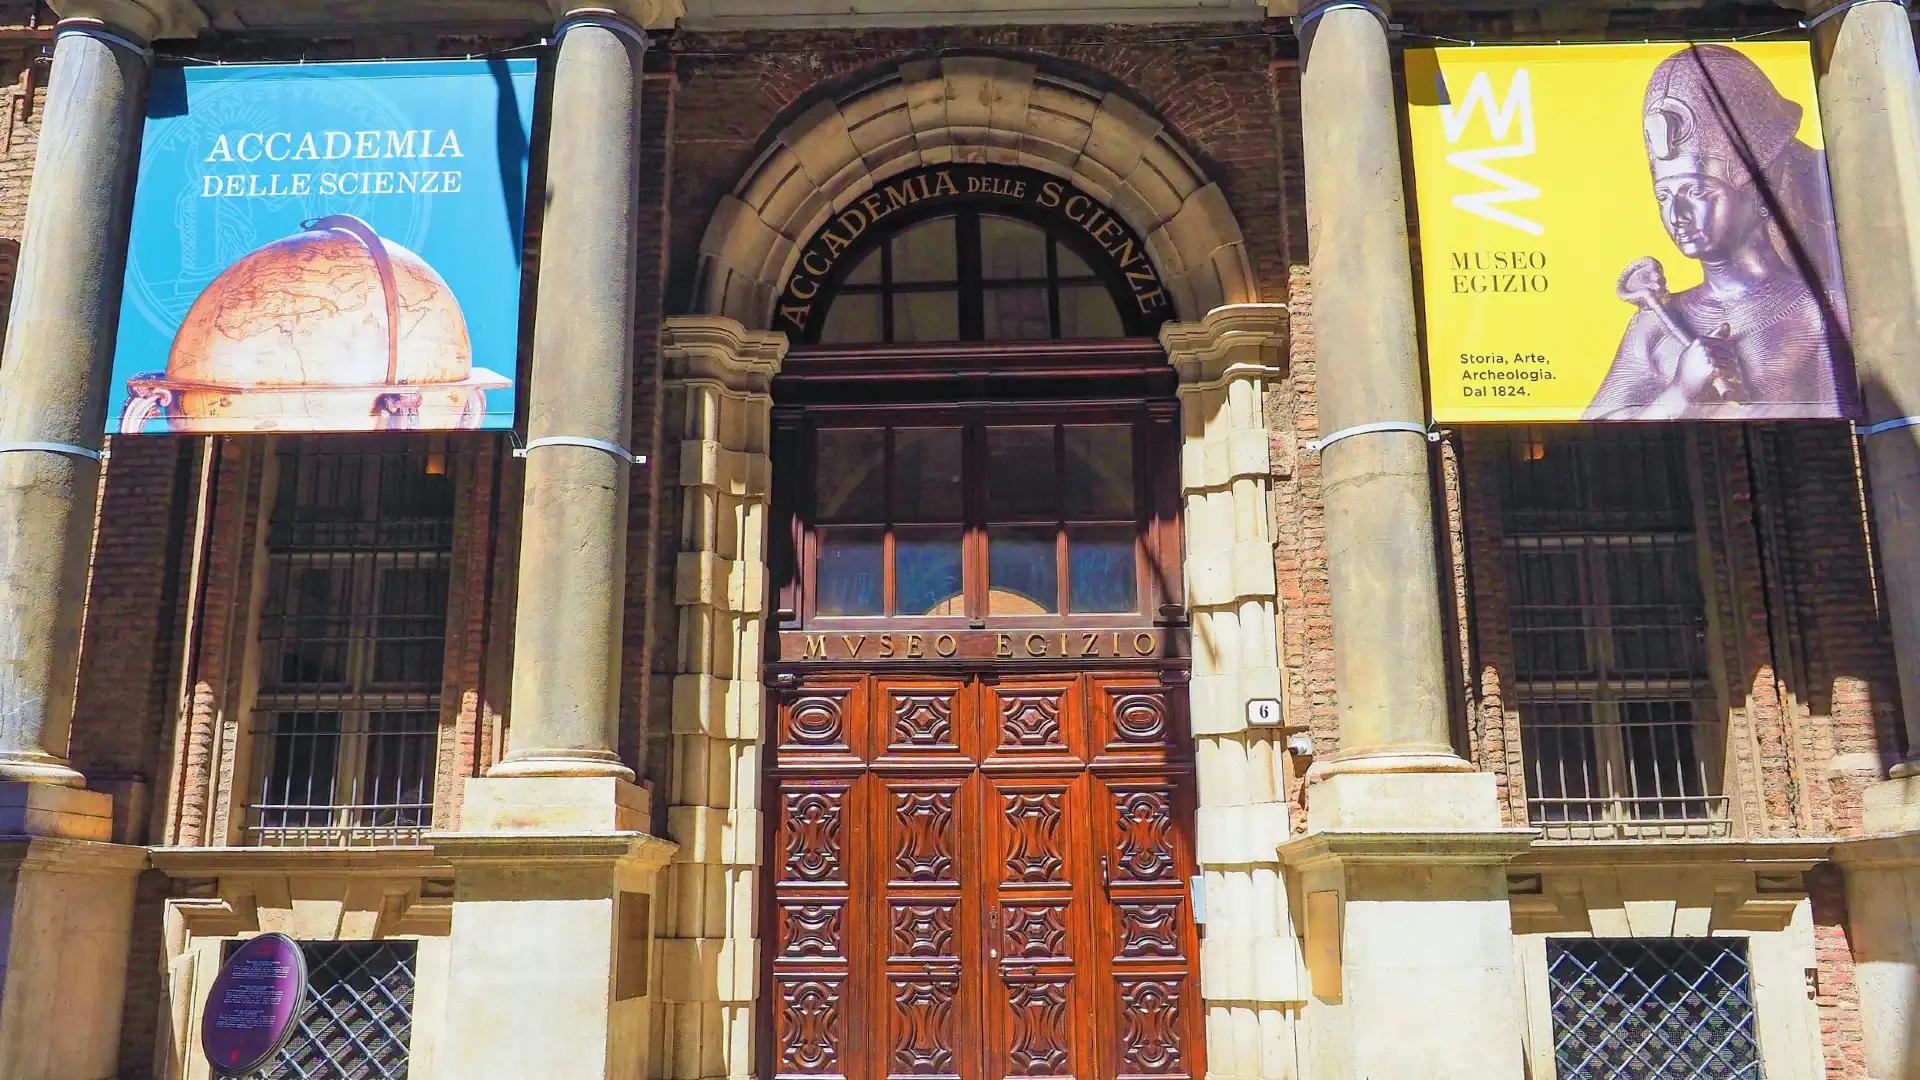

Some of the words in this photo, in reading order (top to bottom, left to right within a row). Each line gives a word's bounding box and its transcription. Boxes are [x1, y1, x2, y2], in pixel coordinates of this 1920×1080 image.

[204, 129, 465, 162] ACCADEMIA
[201, 173, 311, 197] DELLE
[319, 171, 462, 195] SCIENZE
[780, 171, 960, 331] ACCADEMIA
[967, 176, 1027, 198] DELLE
[1036, 181, 1168, 315] SCIENZE
[1450, 251, 1547, 270] MUSEO
[1451, 274, 1549, 293] EGIZIO
[1460, 353, 1509, 365] Storia,
[1513, 353, 1550, 365] Arte,
[1462, 369, 1557, 382] Archeologia.
[1463, 386, 1487, 397] Dal
[1491, 386, 1531, 397] 1824.
[802, 633, 958, 661] MVSEO
[995, 632, 1156, 658] EGIZIO
[1259, 704, 1269, 719] 6
